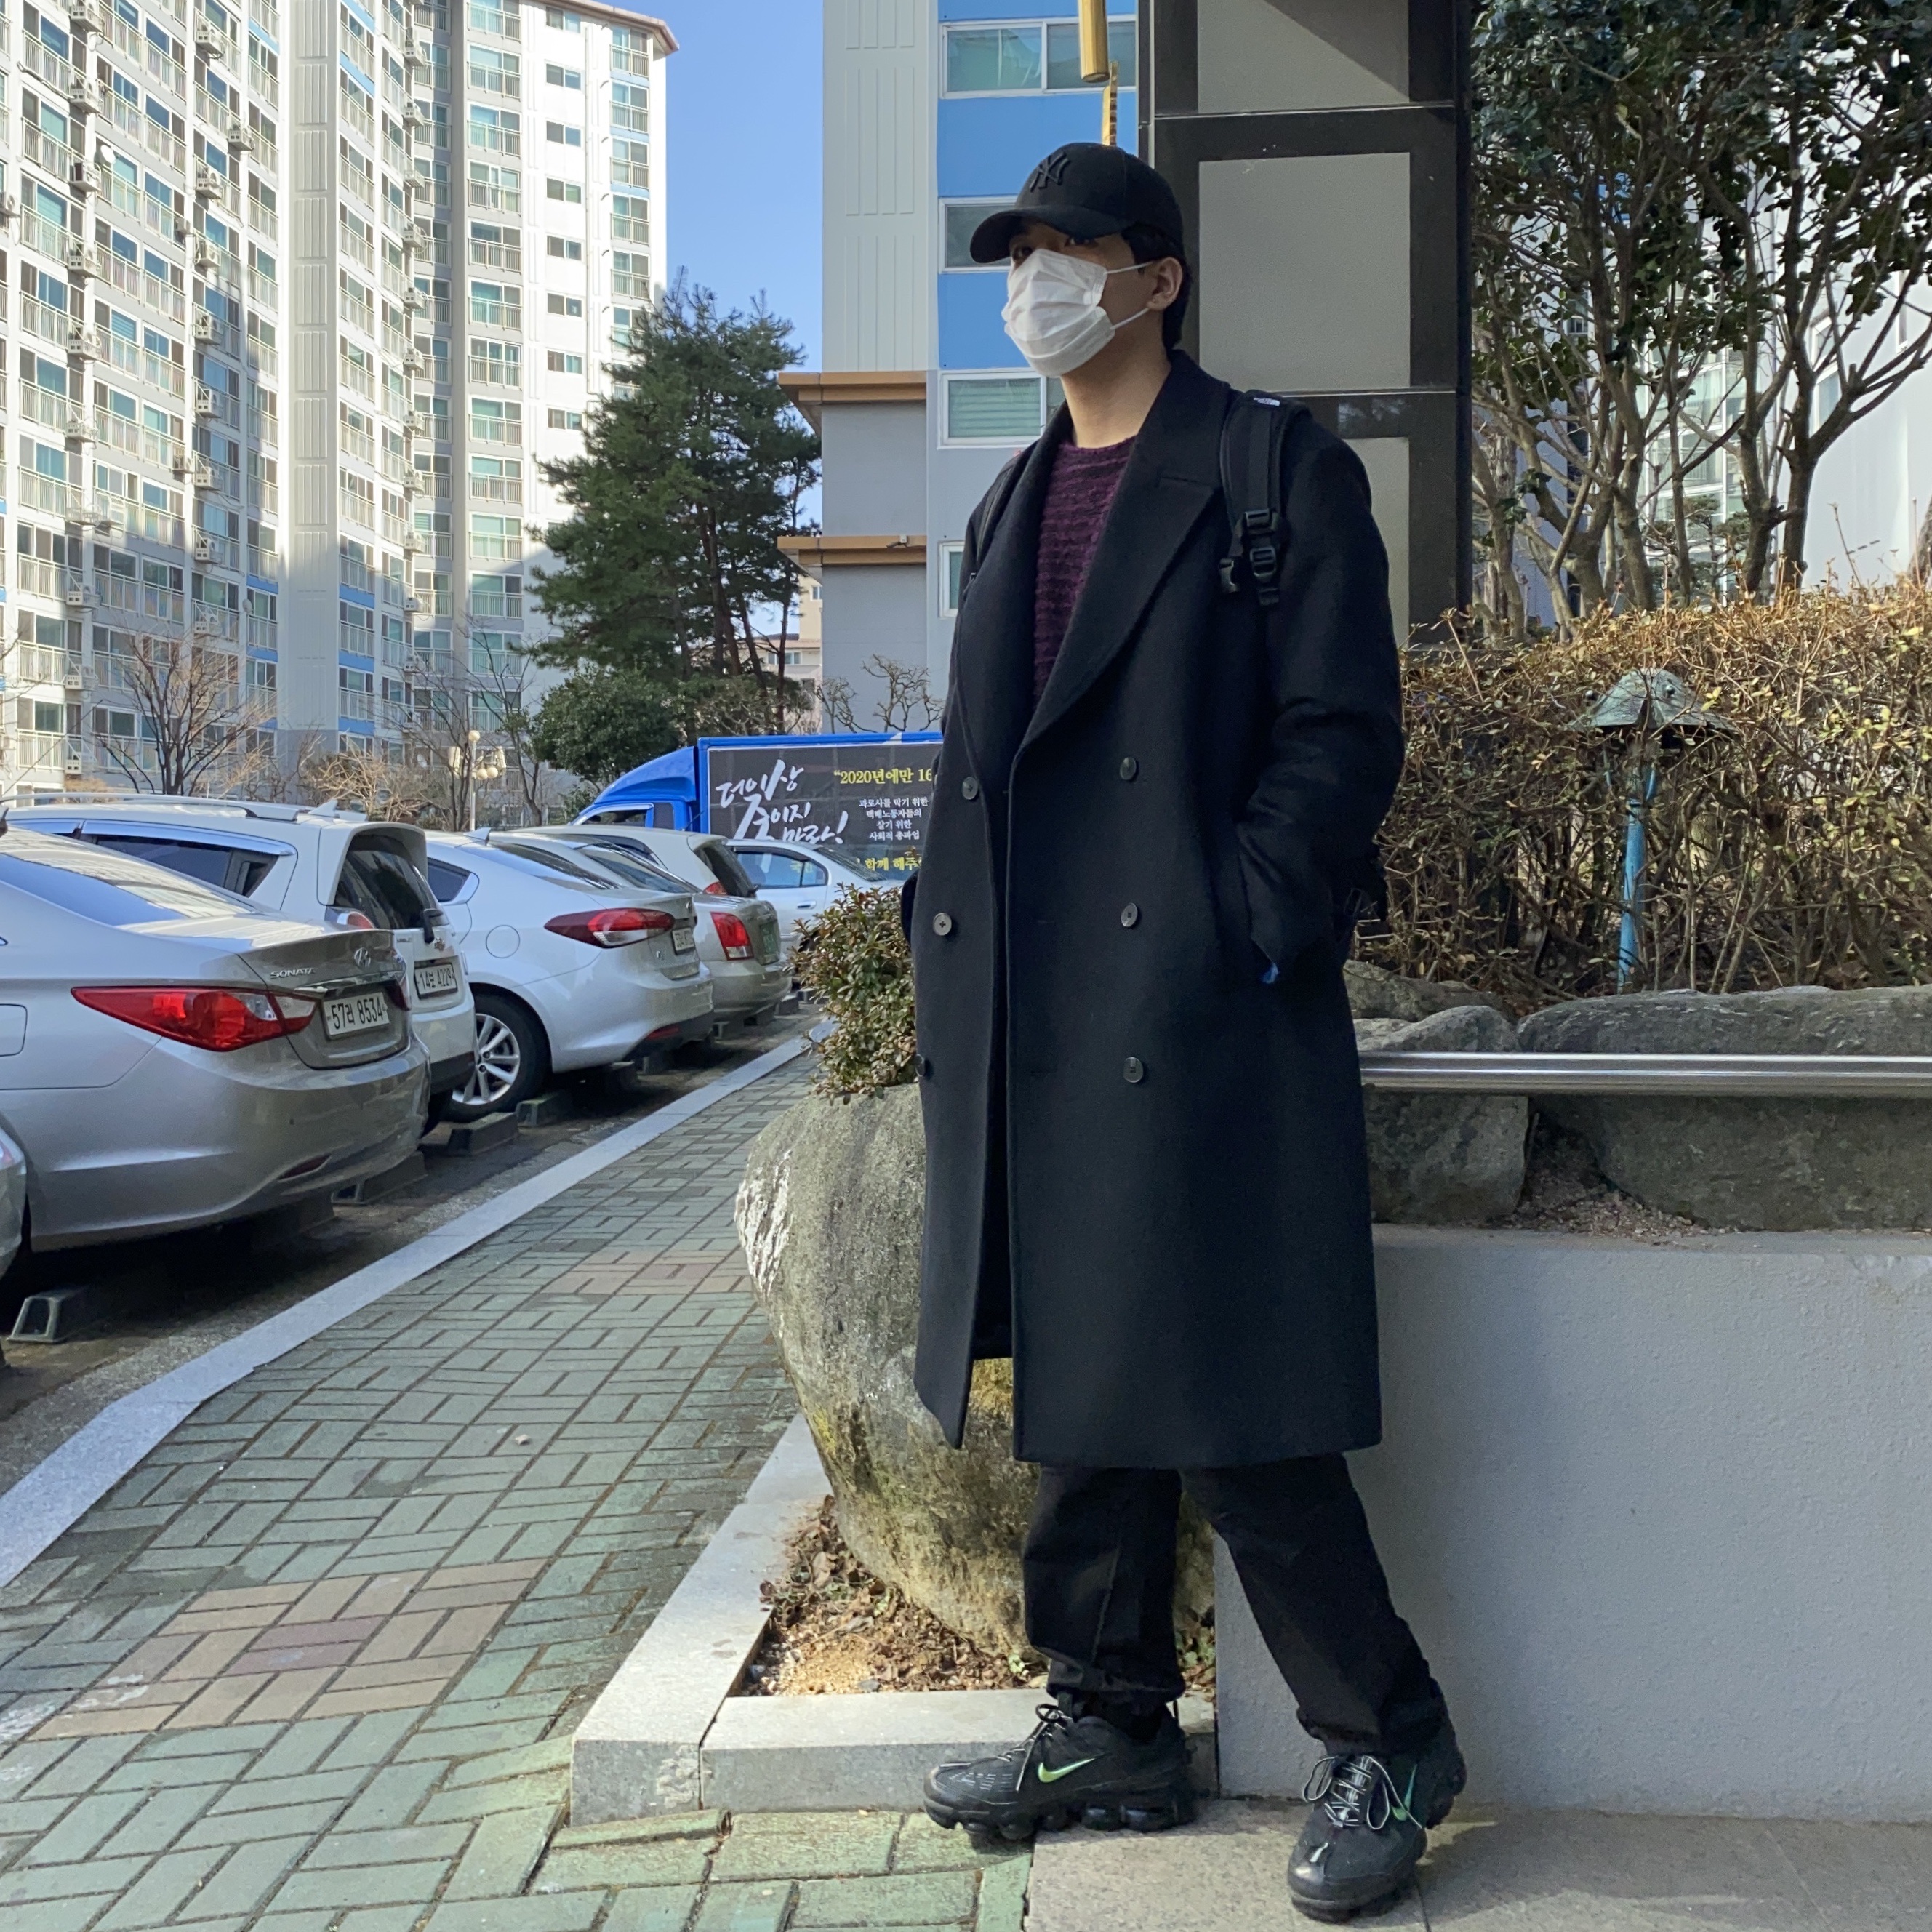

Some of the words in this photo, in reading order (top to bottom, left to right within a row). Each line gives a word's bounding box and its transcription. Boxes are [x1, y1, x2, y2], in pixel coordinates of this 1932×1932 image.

[859, 798, 891, 808] 과로사를
[894, 797, 910, 807] 막기
[912, 796, 929, 807] 위한
[866, 808, 921, 819] 택배노동자들의
[876, 819, 893, 830] 살기
[895, 819, 912, 829] 위한
[869, 830, 893, 841] 사회적
[895, 830, 920, 840] 총파업
[865, 857, 889, 871] 함께
[893, 856, 922, 871] 해주
[270, 967, 316, 979] SONATA
[357, 996, 384, 1024] 8534
